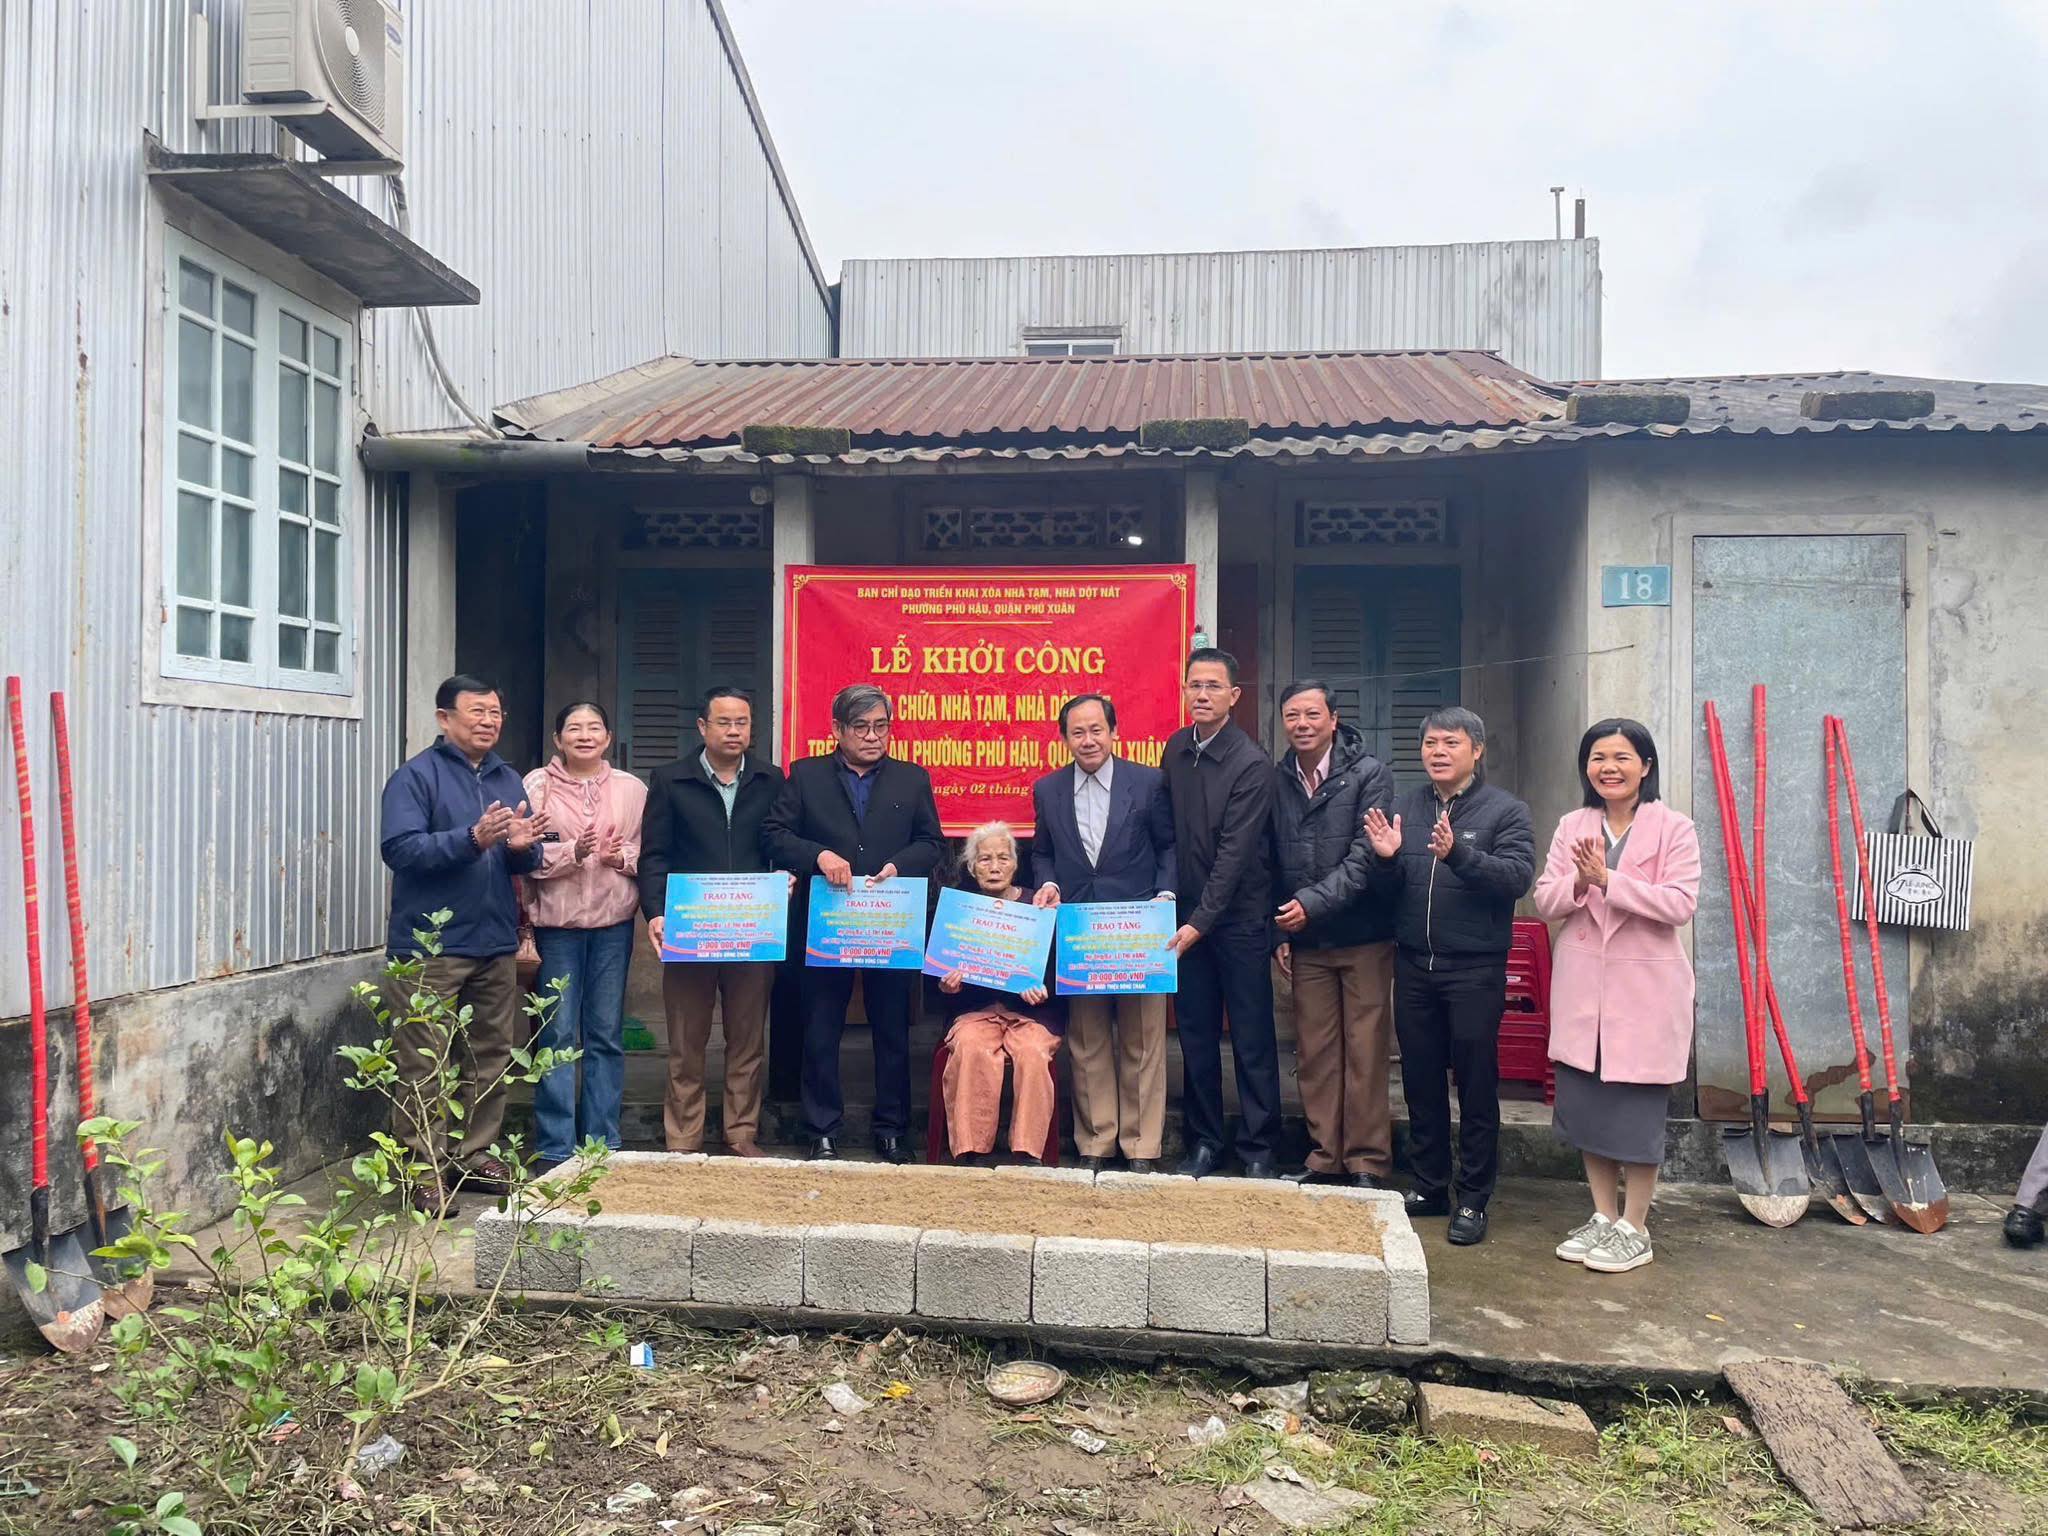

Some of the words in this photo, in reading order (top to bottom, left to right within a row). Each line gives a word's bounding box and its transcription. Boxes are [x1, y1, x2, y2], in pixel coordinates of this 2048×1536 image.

[857, 587, 878, 598] BAN
[881, 584, 898, 598] CHỈ
[923, 583, 953, 598] TRIỂN
[955, 587, 979, 598] KHAI
[1004, 585, 1025, 598] NHÀ
[1027, 587, 1052, 600] TẠM,
[1055, 585, 1076, 598] NHÀ
[1100, 585, 1120, 598] NÁT
[1620, 572, 1653, 600] 18
[902, 601, 943, 614] PHƯỜNG
[945, 601, 966, 614] PHÚ
[968, 602, 992, 616] HẬU,
[994, 602, 1021, 616] QUẬN
[1024, 602, 1044, 614] PHÚ
[1047, 602, 1075, 614] XUÂN
[870, 634, 912, 674] LỄ
[922, 639, 1005, 674] KHỞI
[1015, 640, 1106, 674] CÔNG
[898, 689, 938, 721] CHỮA
[941, 690, 972, 721] NHÀ
[976, 694, 1011, 727] TẠM,
[1015, 689, 1046, 721] NHÀ
[912, 734, 973, 767] PHƯỜNG
[976, 735, 1006, 767] PHÚ
[1009, 735, 1043, 772] HẬU,
[933, 783, 967, 796] ngày
[970, 783, 986, 794] 02
[989, 783, 1029, 796] tháng
[704, 892, 727, 901] TRAO
[846, 900, 867, 908] TRAO
[1091, 922, 1115, 930] TRAO
